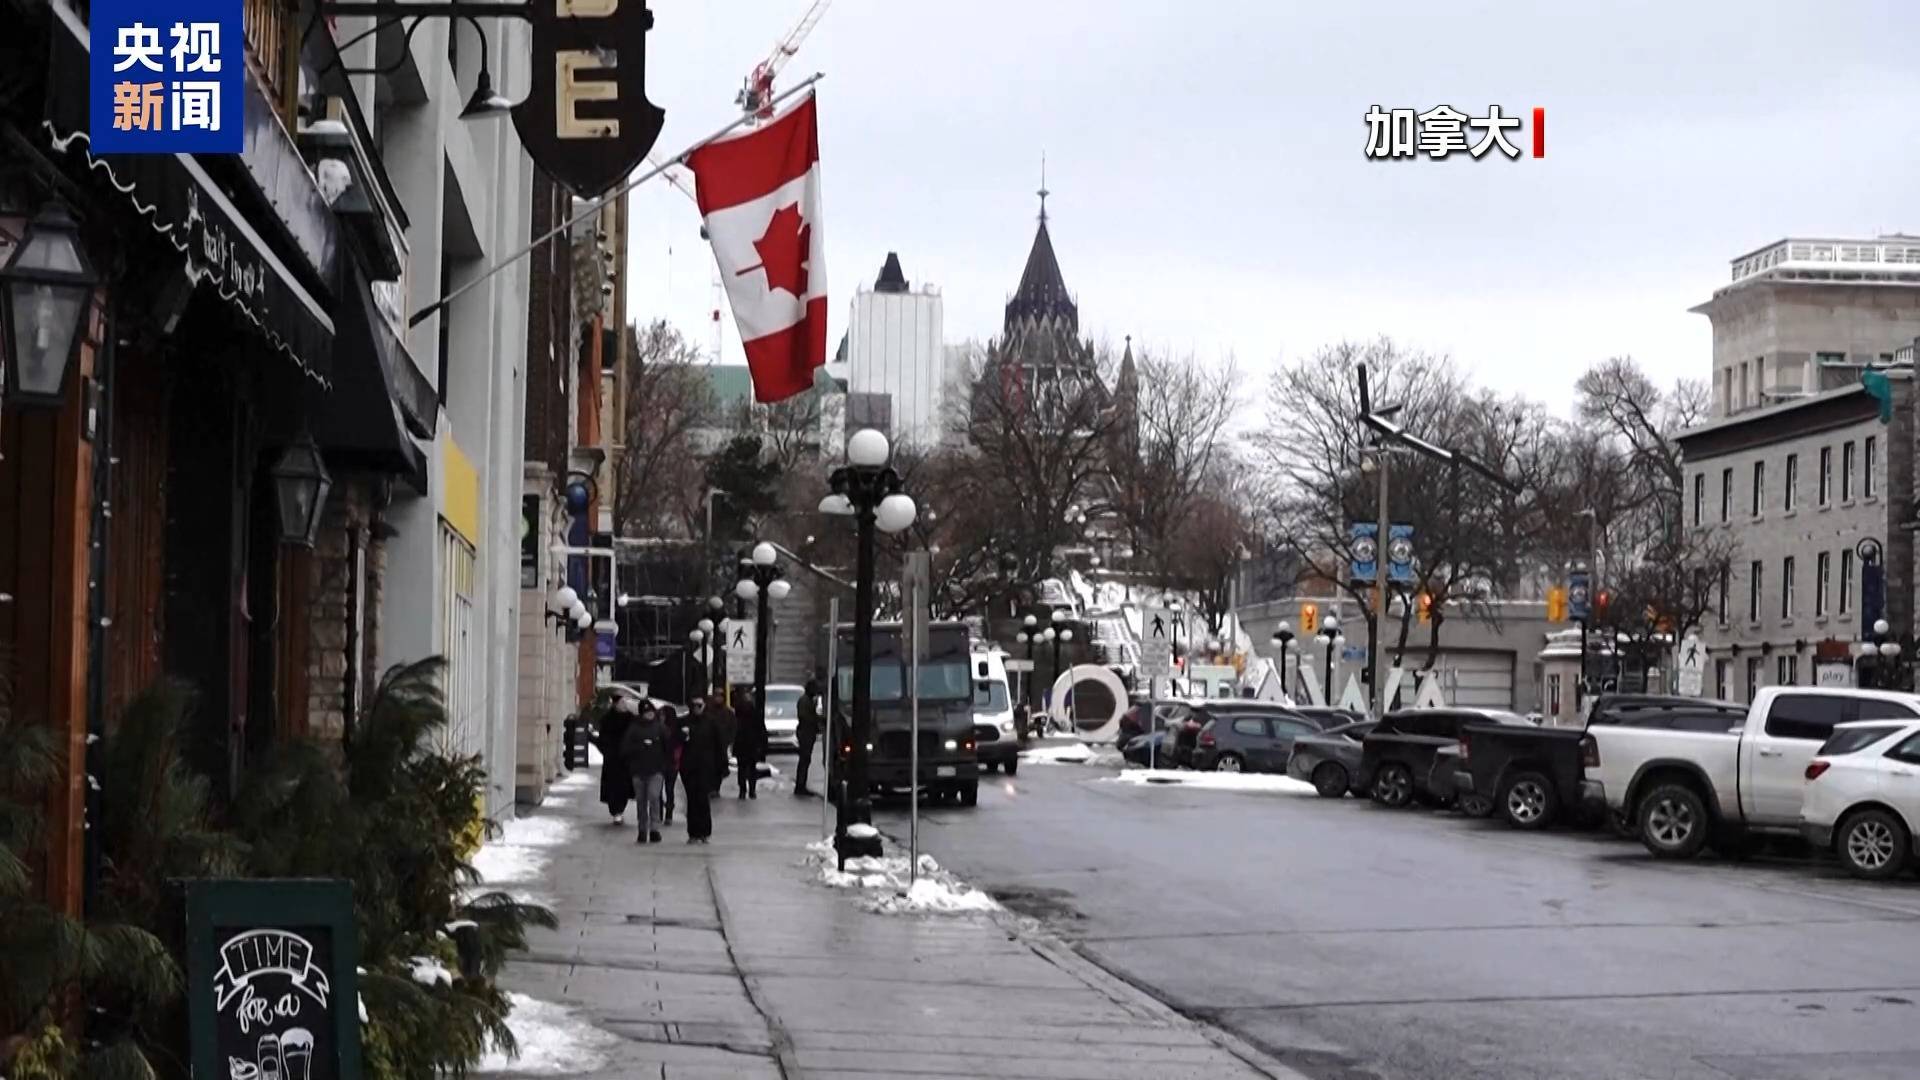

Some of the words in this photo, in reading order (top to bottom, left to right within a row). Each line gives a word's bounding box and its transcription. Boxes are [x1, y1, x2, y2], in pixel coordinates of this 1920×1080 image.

[556, 0, 620, 138] E
[1822, 670, 1845, 682] play
[230, 936, 303, 975] TIME
[236, 984, 273, 1034] for
[274, 993, 301, 1017] a
